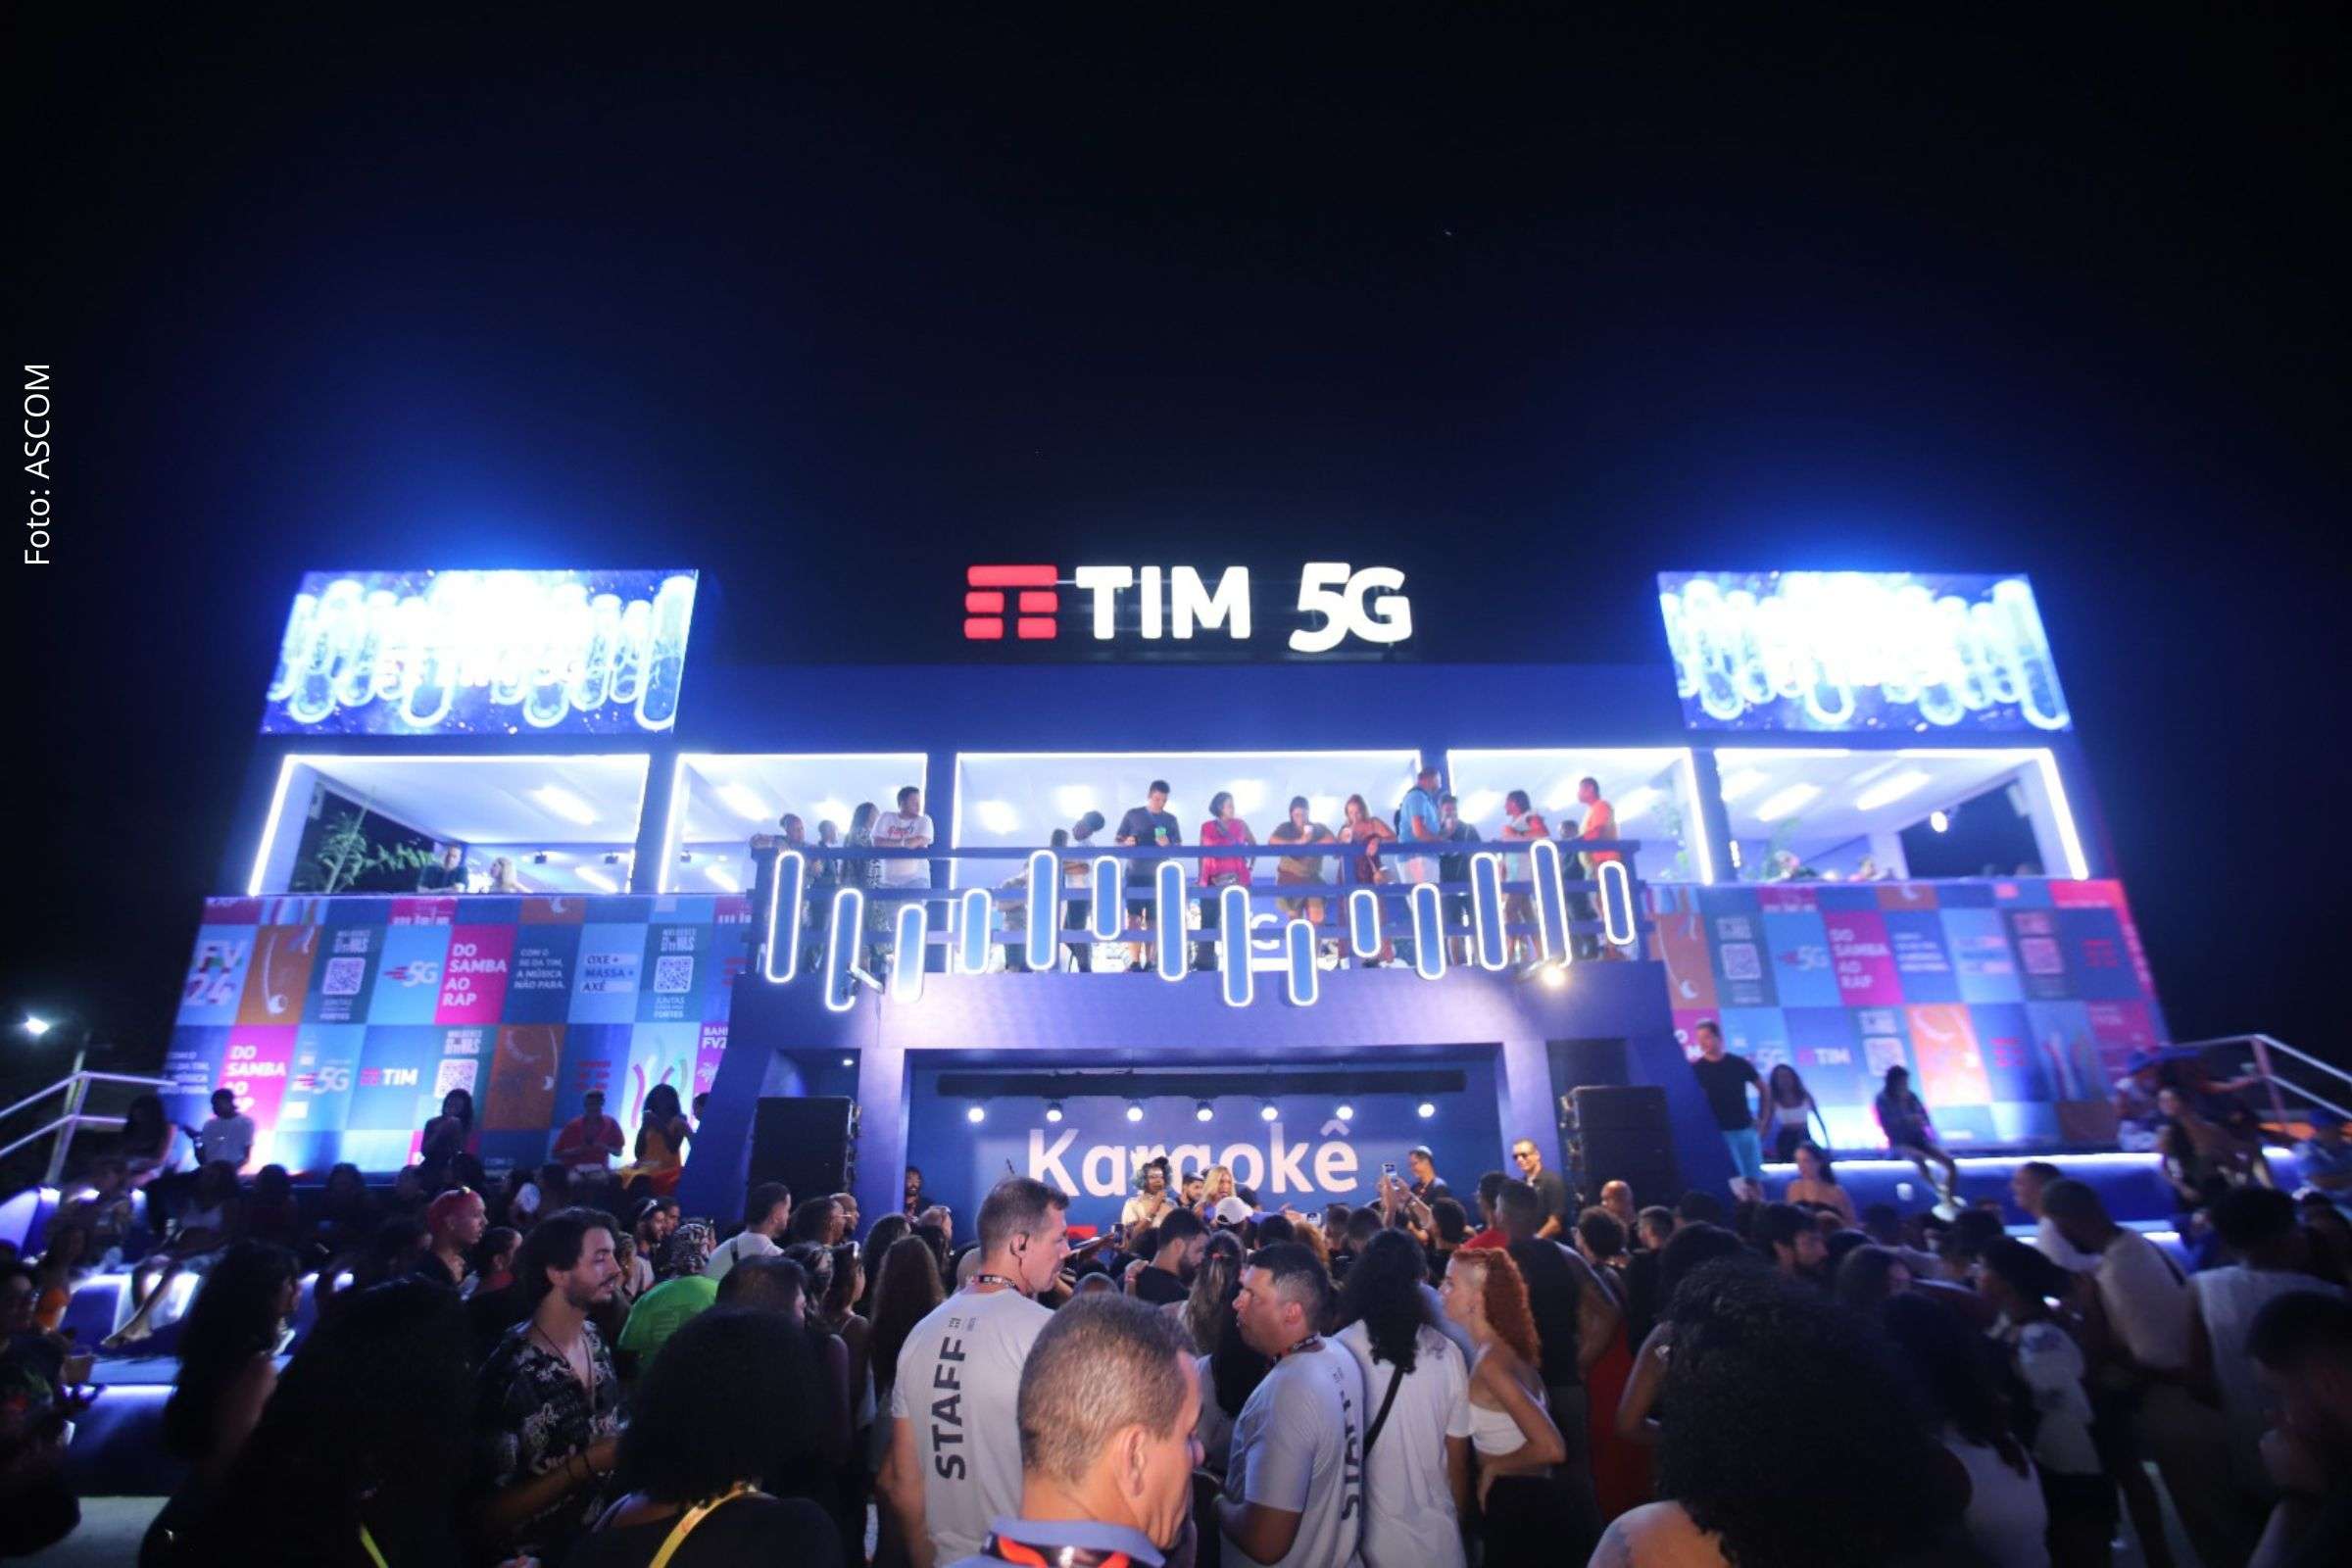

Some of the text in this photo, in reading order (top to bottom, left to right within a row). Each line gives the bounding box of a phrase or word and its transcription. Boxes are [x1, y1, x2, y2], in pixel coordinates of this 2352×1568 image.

[1075, 562, 1413, 654] TIM 5G
[452, 944, 477, 957] DO
[403, 960, 439, 988] 5G
[449, 959, 508, 973] SAMBA
[585, 968, 625, 978] MASSA
[445, 977, 470, 991] AO
[442, 993, 477, 1006] RAP
[230, 1045, 257, 1059] DO
[1814, 1047, 1850, 1064] TIM
[226, 1061, 286, 1077] SAMBA
[381, 1067, 418, 1086] TIM
[313, 1066, 350, 1095] 5G
[931, 1336, 966, 1481] STAFF
